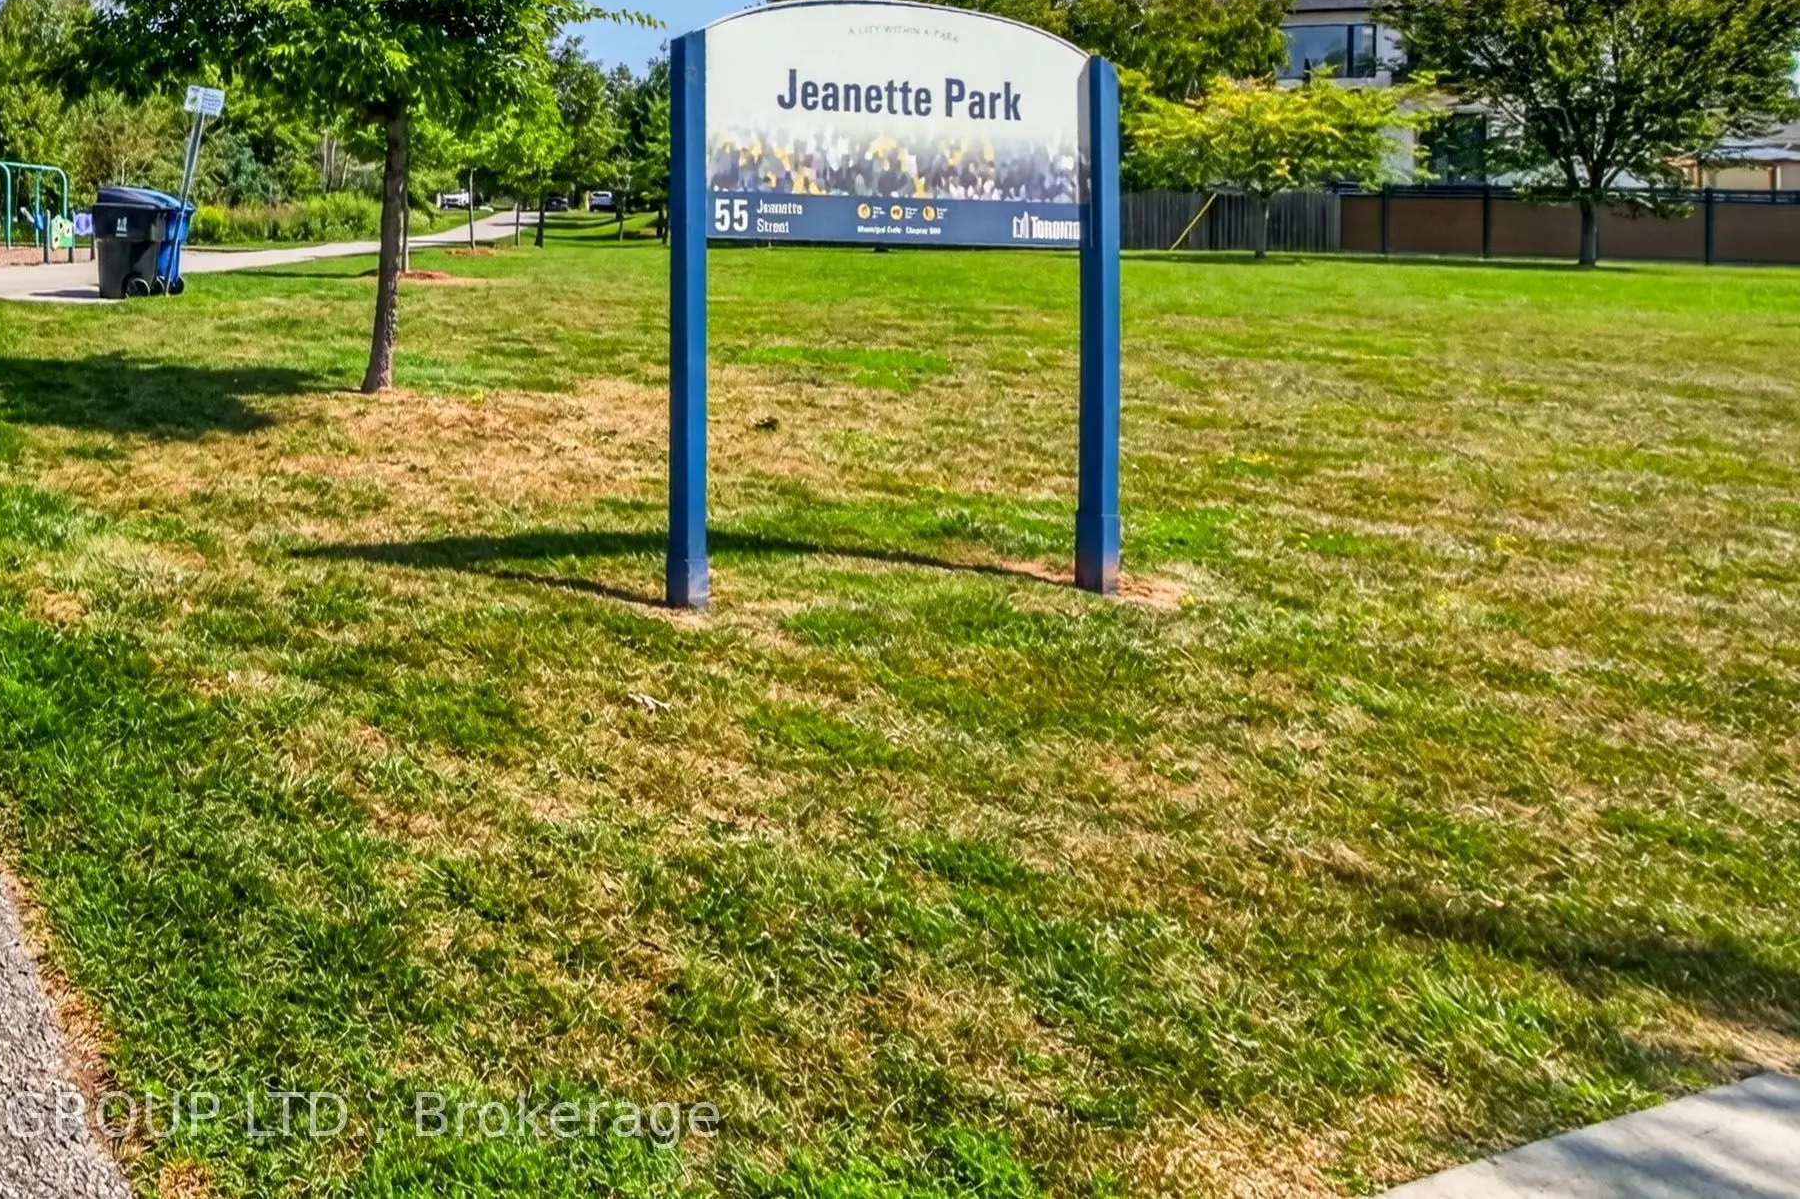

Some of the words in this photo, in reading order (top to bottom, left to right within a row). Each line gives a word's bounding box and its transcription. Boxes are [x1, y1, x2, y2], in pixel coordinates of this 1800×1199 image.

[883, 24, 921, 35] WITHIN
[777, 68, 932, 117] Jeanette
[945, 77, 1022, 121] Park
[714, 198, 749, 232] 55
[756, 199, 803, 215] Jeanette
[756, 218, 790, 234] Street
